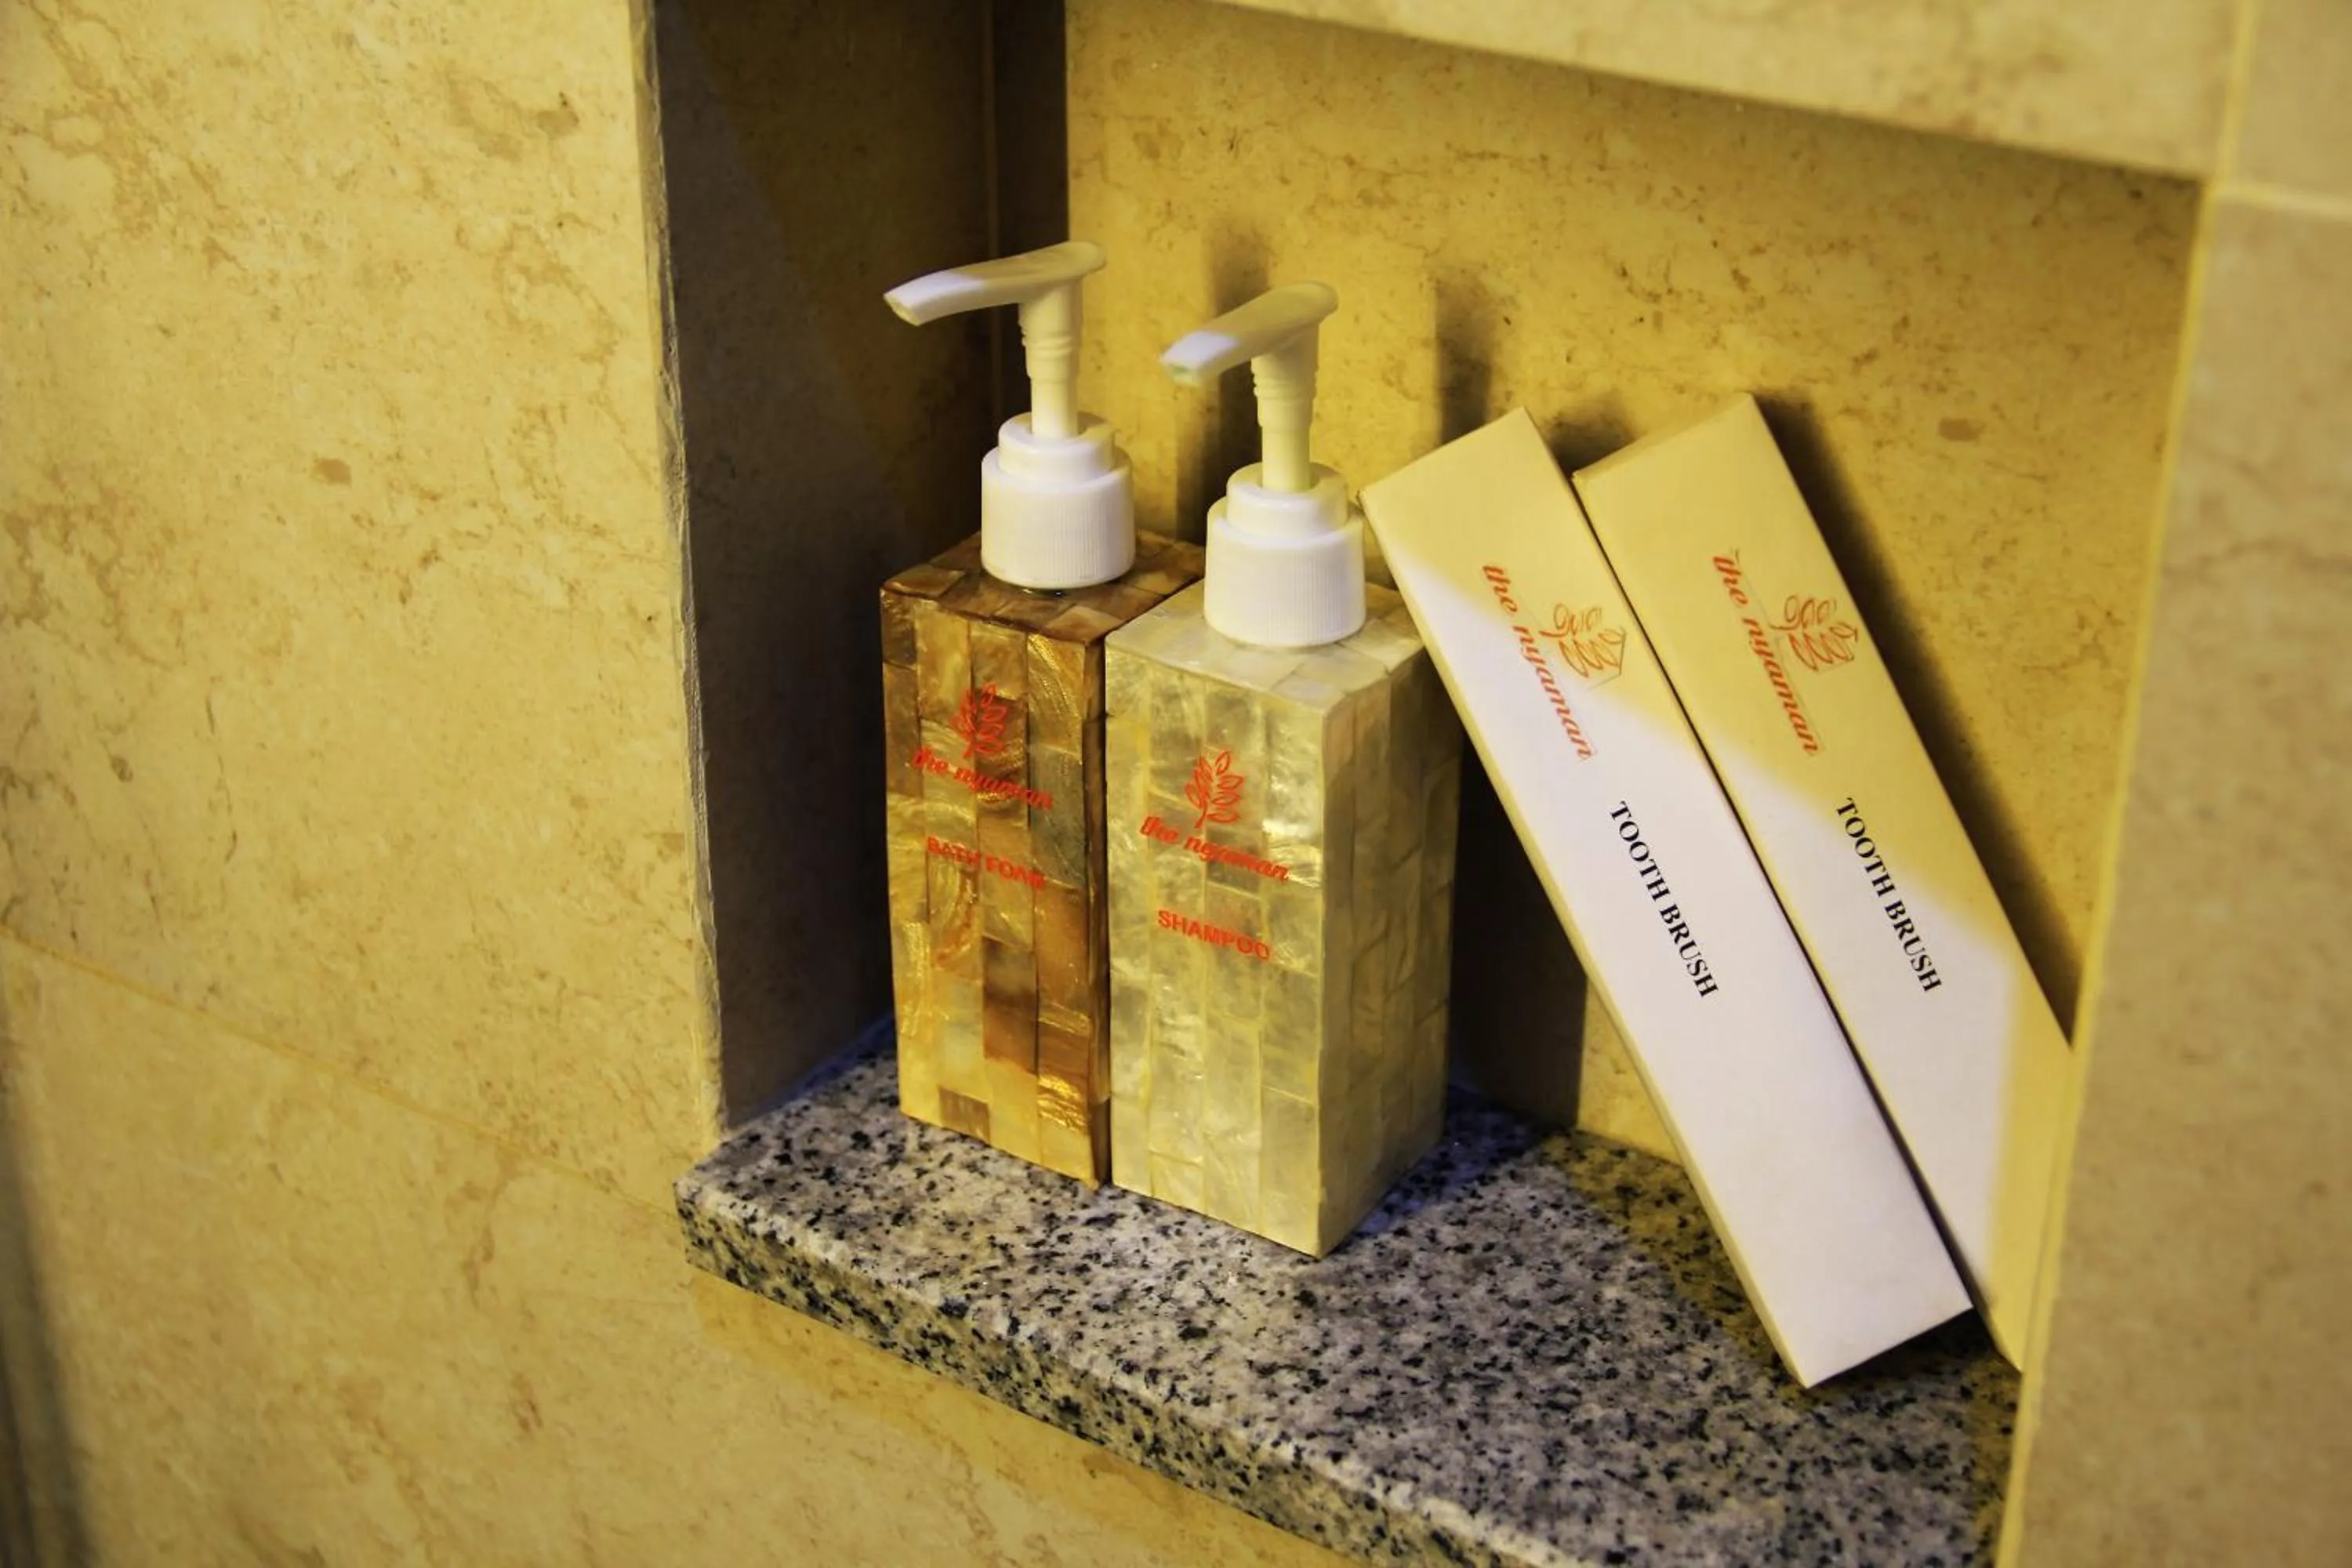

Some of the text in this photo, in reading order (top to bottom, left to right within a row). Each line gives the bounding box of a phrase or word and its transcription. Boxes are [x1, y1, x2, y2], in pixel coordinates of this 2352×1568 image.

[1483, 564, 1592, 759] the nyaman
[1712, 555, 1819, 753] the nyaman
[927, 836, 980, 866] BATH
[1140, 815, 1179, 845] the
[1610, 800, 1719, 998] TOOTH BRUSH
[1836, 796, 1942, 993] TOOTH BRUSH
[1157, 909, 1271, 960] SHAMPOO
